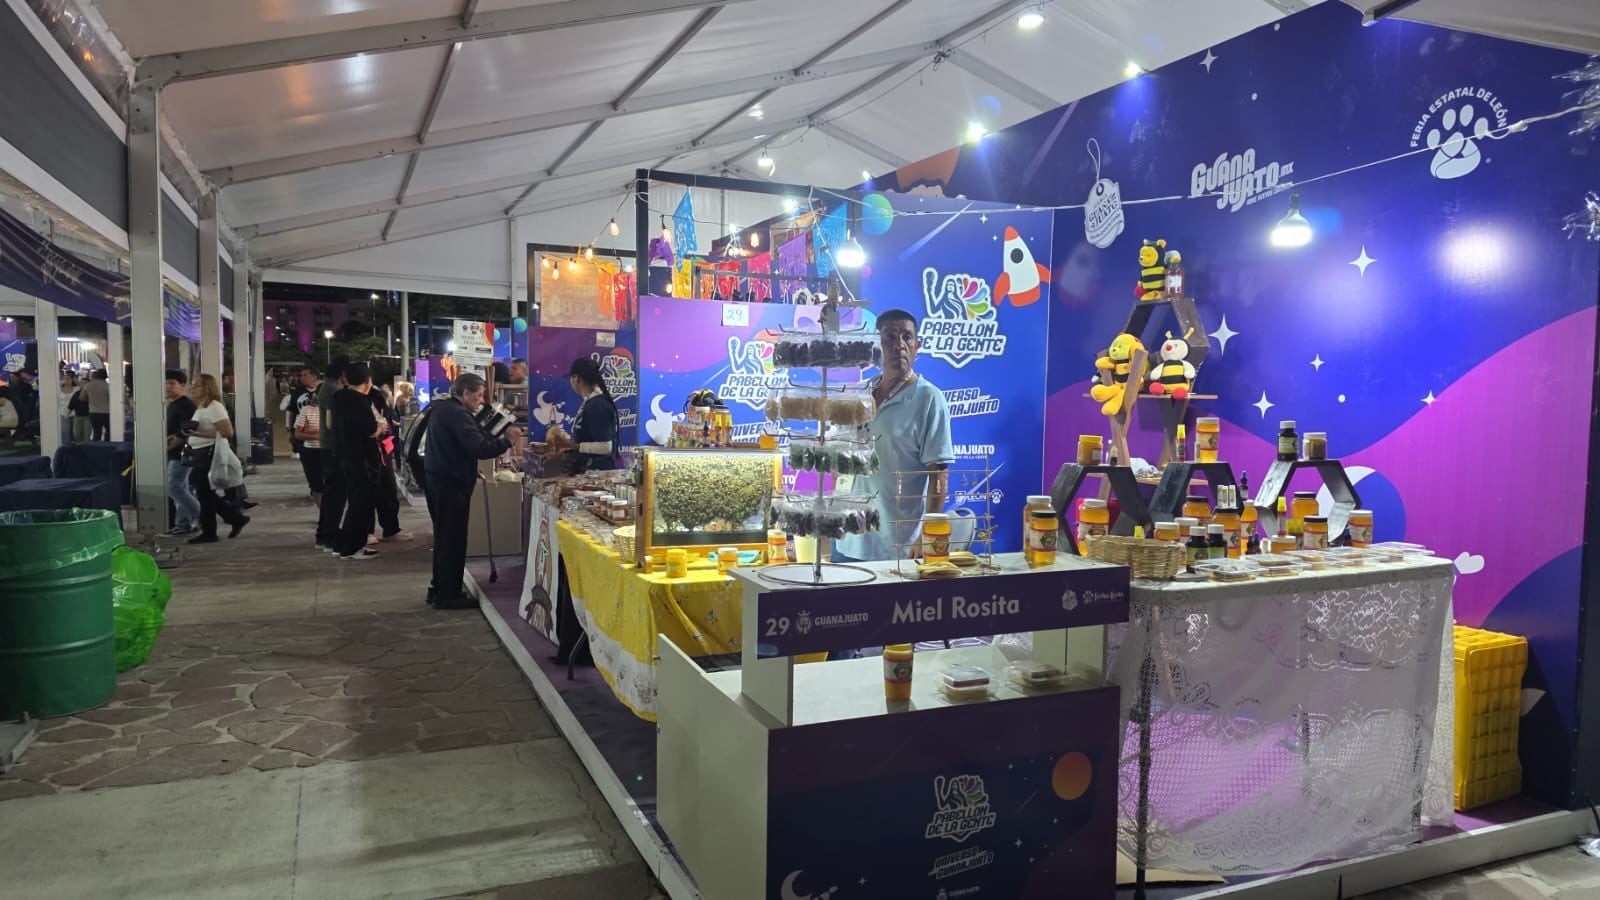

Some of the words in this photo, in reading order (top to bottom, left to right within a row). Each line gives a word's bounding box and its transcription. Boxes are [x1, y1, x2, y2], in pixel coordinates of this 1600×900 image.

[1410, 113, 1431, 147] FERIA
[1428, 87, 1475, 114] ESTATAL
[1476, 87, 1493, 102] DE
[1488, 97, 1509, 128] LEÓN
[726, 308, 744, 321] 29
[922, 321, 995, 338] PABELLON
[936, 337, 954, 351] LA
[957, 338, 1003, 352] GENTE
[604, 379, 633, 387] BELLON
[720, 387, 737, 398] DE
[740, 387, 755, 398] LA
[944, 388, 979, 403] VERSO
[949, 399, 999, 417] NAJUATO
[952, 444, 995, 455] NAJUATO
[892, 597, 943, 624] Miel
[951, 593, 1021, 619] Rosita
[765, 616, 790, 636] 29
[814, 612, 869, 626] GUANAJUATO
[927, 822, 943, 836] DE
[944, 819, 959, 833] LA
[959, 813, 995, 831] GENTE
